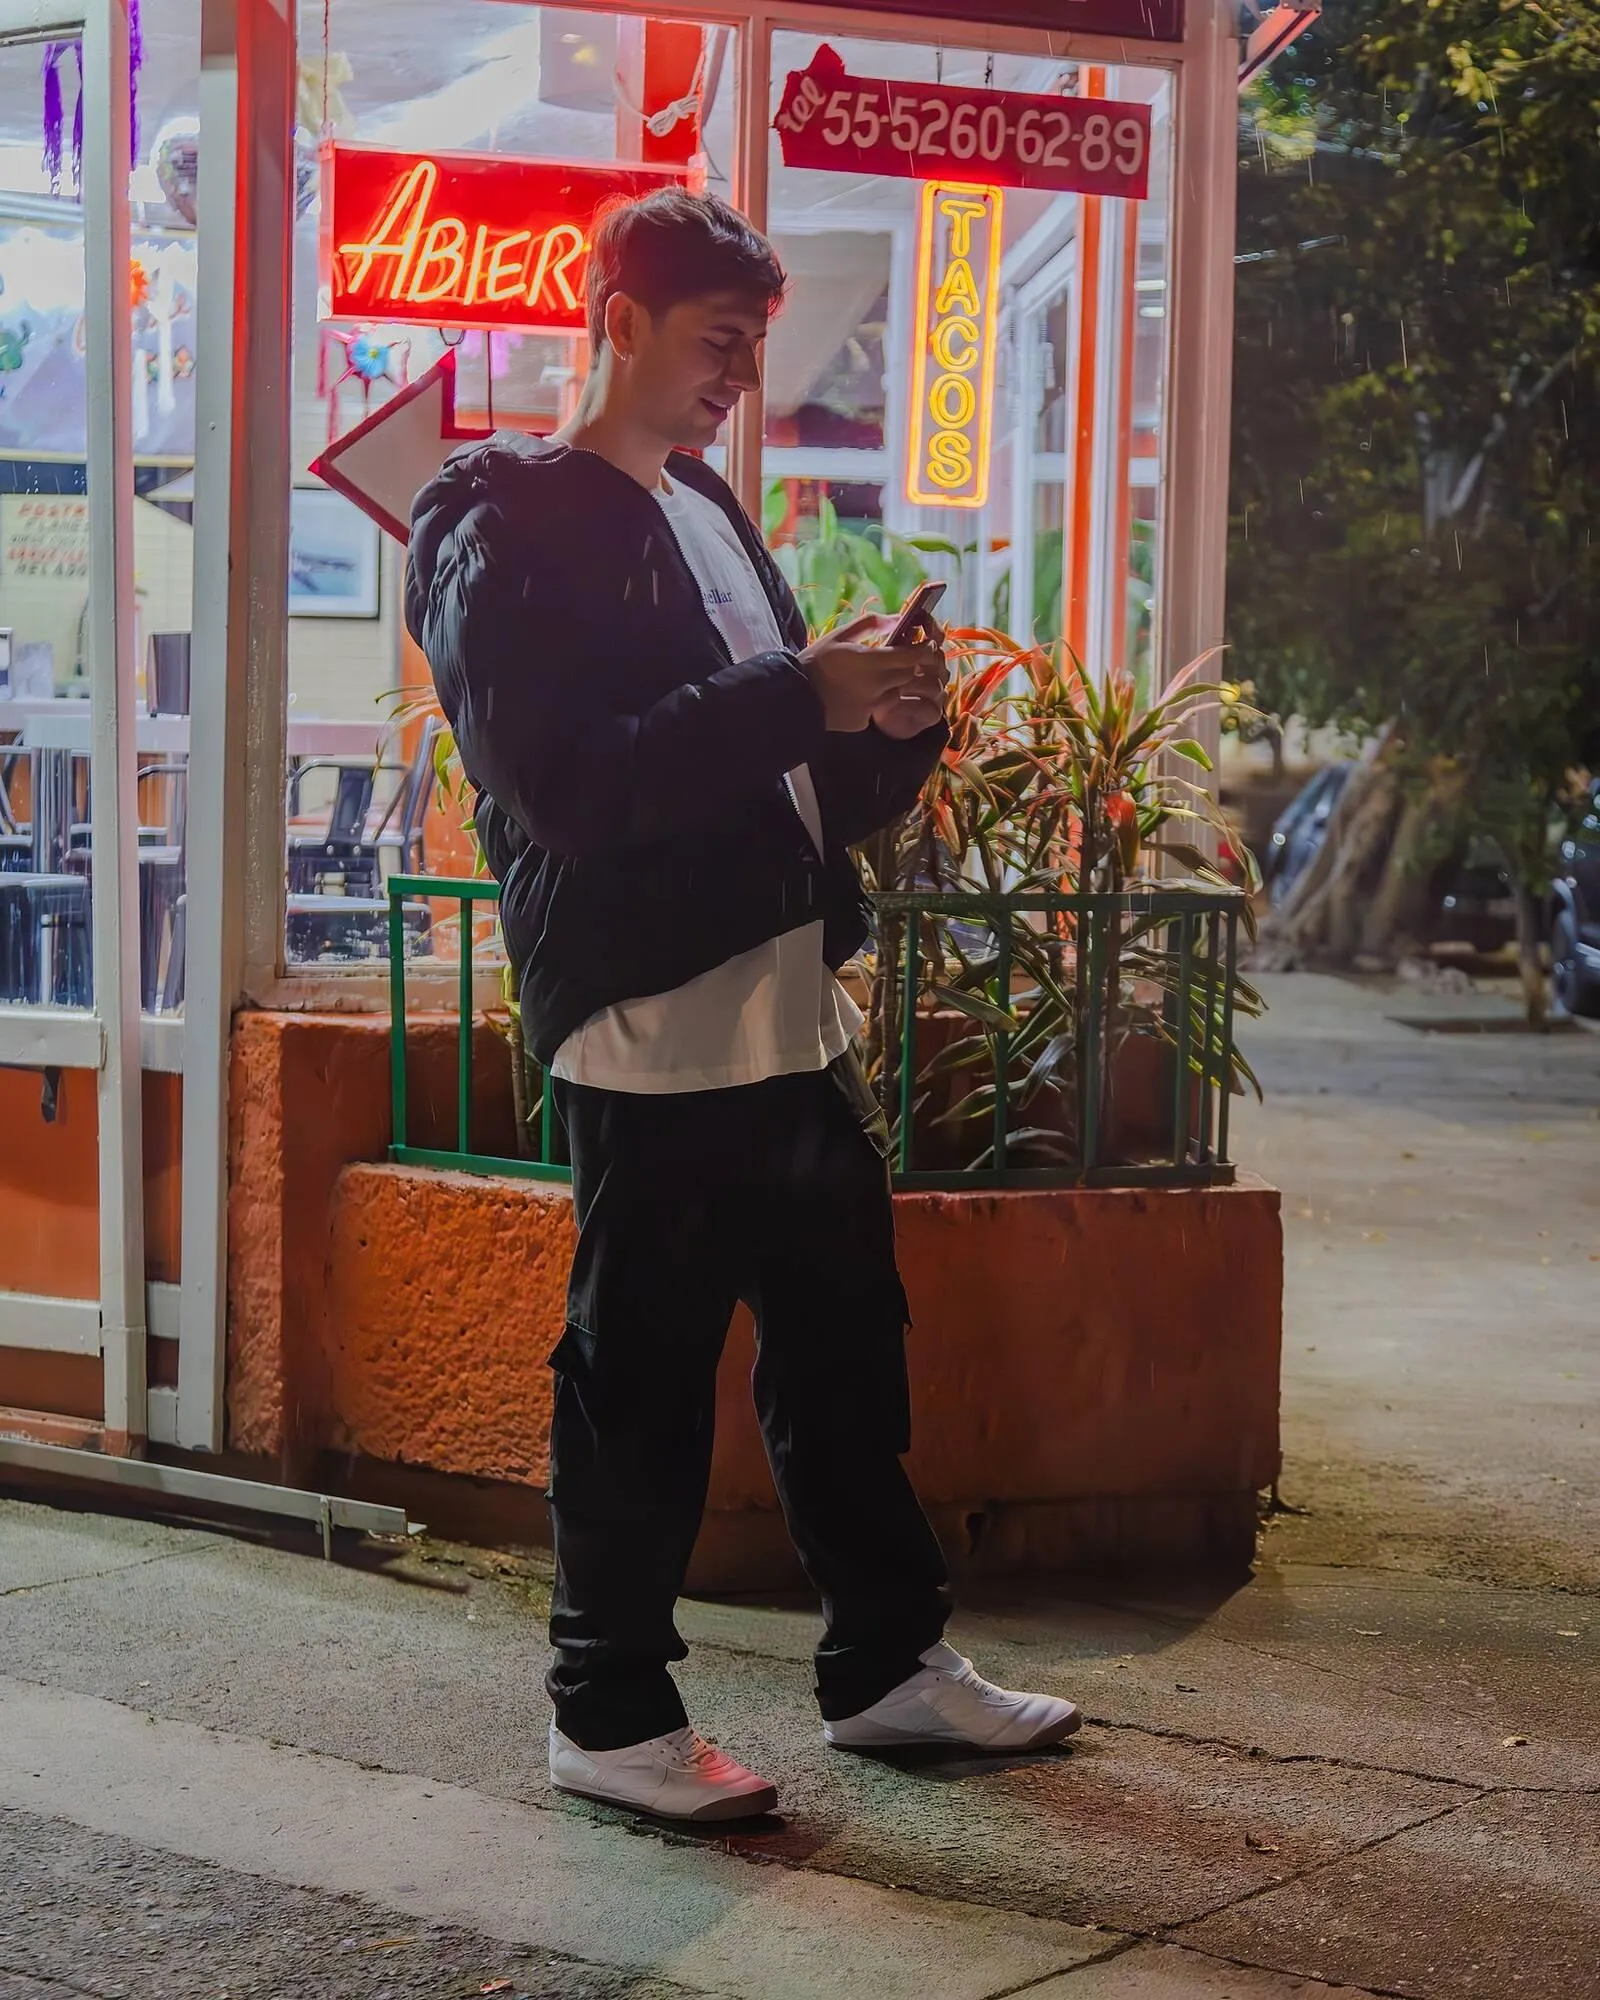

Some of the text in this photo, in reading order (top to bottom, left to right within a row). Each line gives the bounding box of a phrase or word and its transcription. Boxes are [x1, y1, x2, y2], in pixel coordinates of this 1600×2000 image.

[821, 91, 1144, 175] 55-5260-62-89
[338, 160, 587, 310] ABIER
[926, 199, 987, 489] TACOS
